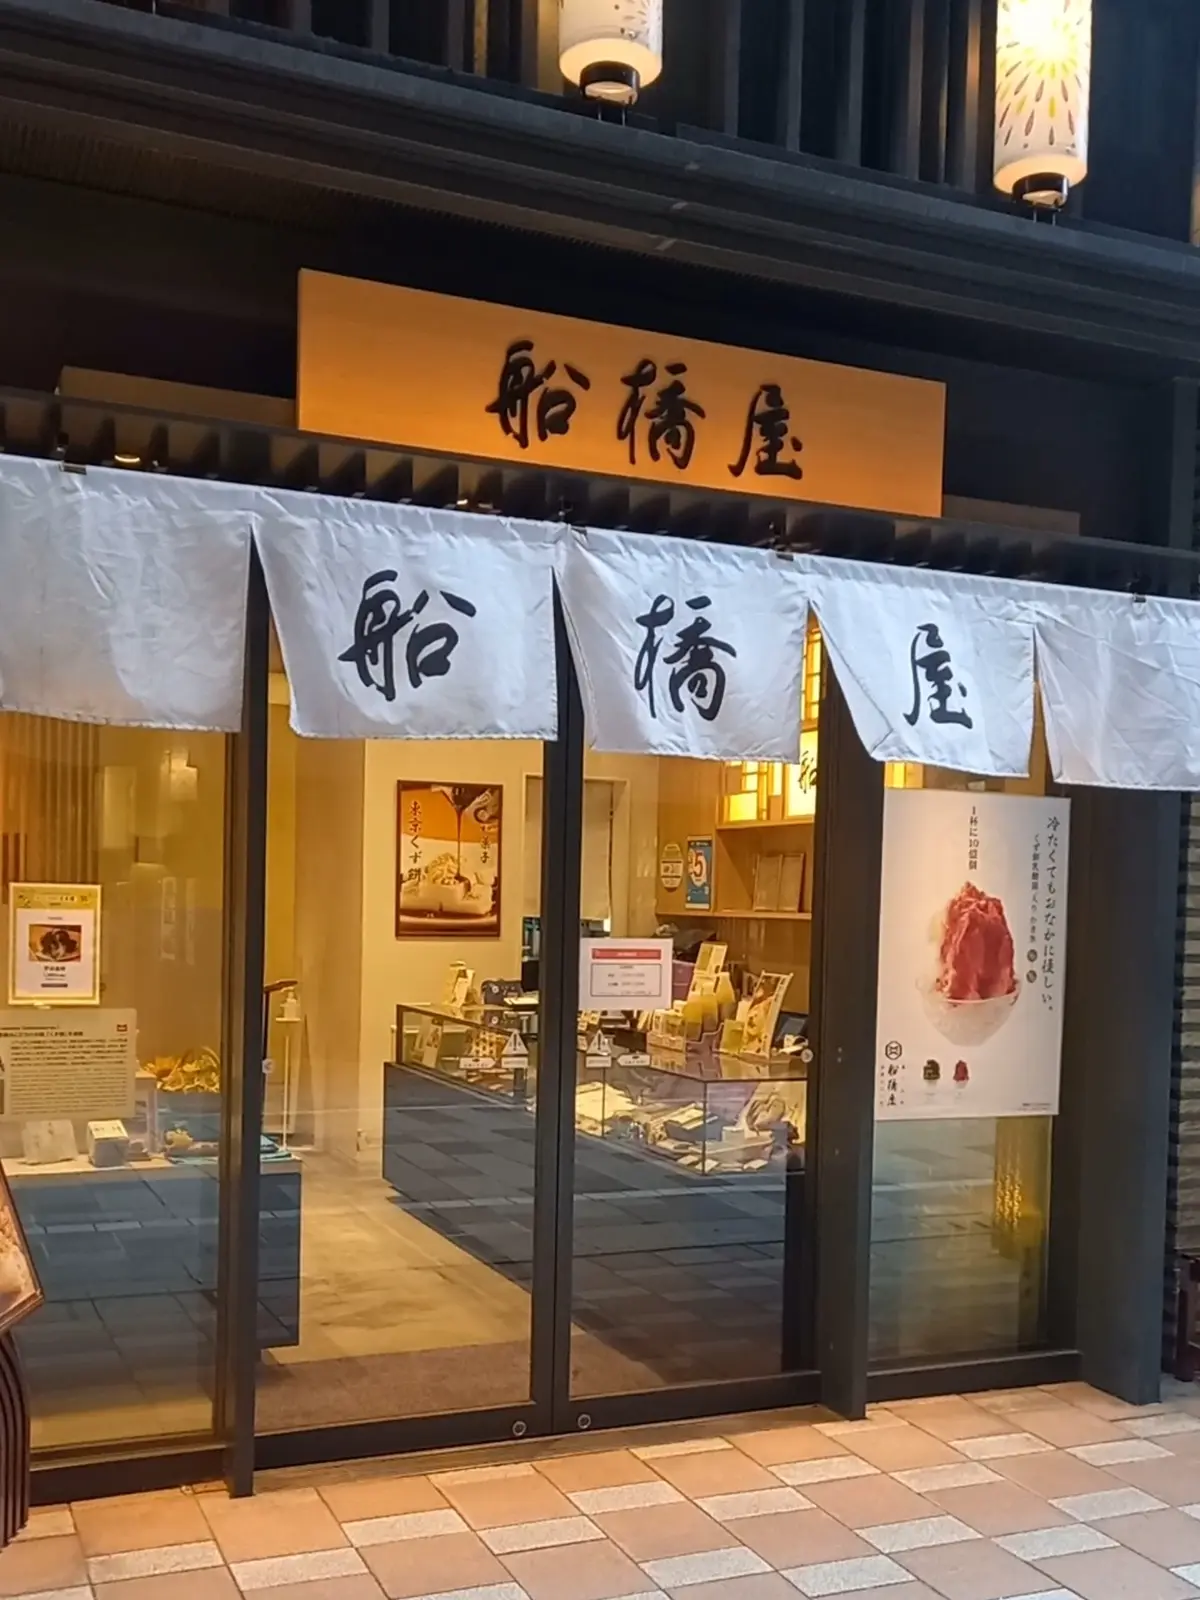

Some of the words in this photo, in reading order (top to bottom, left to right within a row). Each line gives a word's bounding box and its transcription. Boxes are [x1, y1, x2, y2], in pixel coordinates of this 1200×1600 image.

[485, 339, 803, 480] 船橋屋
[338, 569, 974, 729] 船橋屋
[1041, 816, 1061, 1011] 冷たくてもおなかに優しい。
